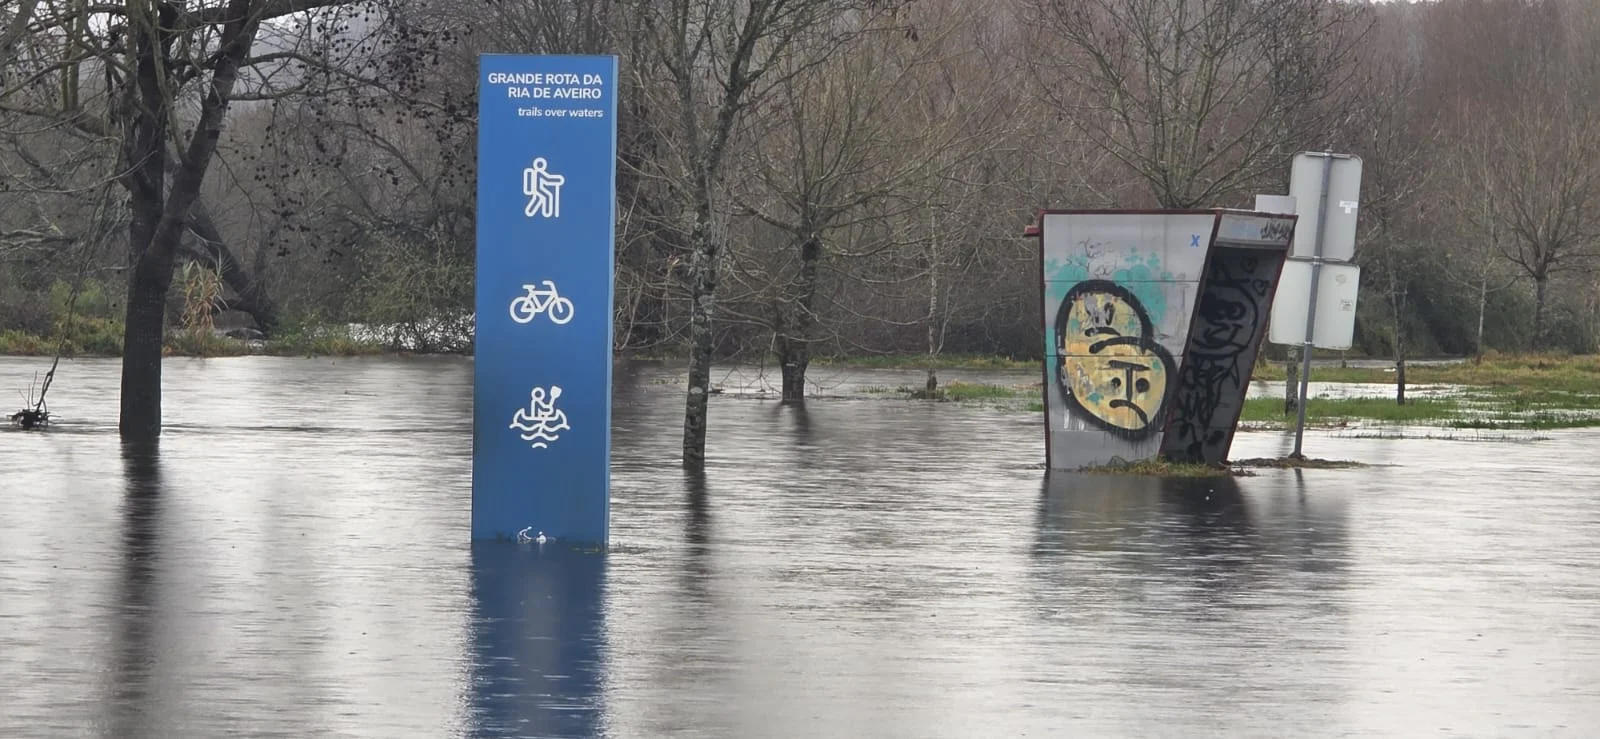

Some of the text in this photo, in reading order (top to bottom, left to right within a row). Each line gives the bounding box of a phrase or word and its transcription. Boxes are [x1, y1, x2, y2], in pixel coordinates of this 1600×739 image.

[488, 73, 603, 85] GRANDE ROTA DA
[508, 87, 602, 99] RIA DE AVEIRO
[518, 107, 603, 118] trails over waters
